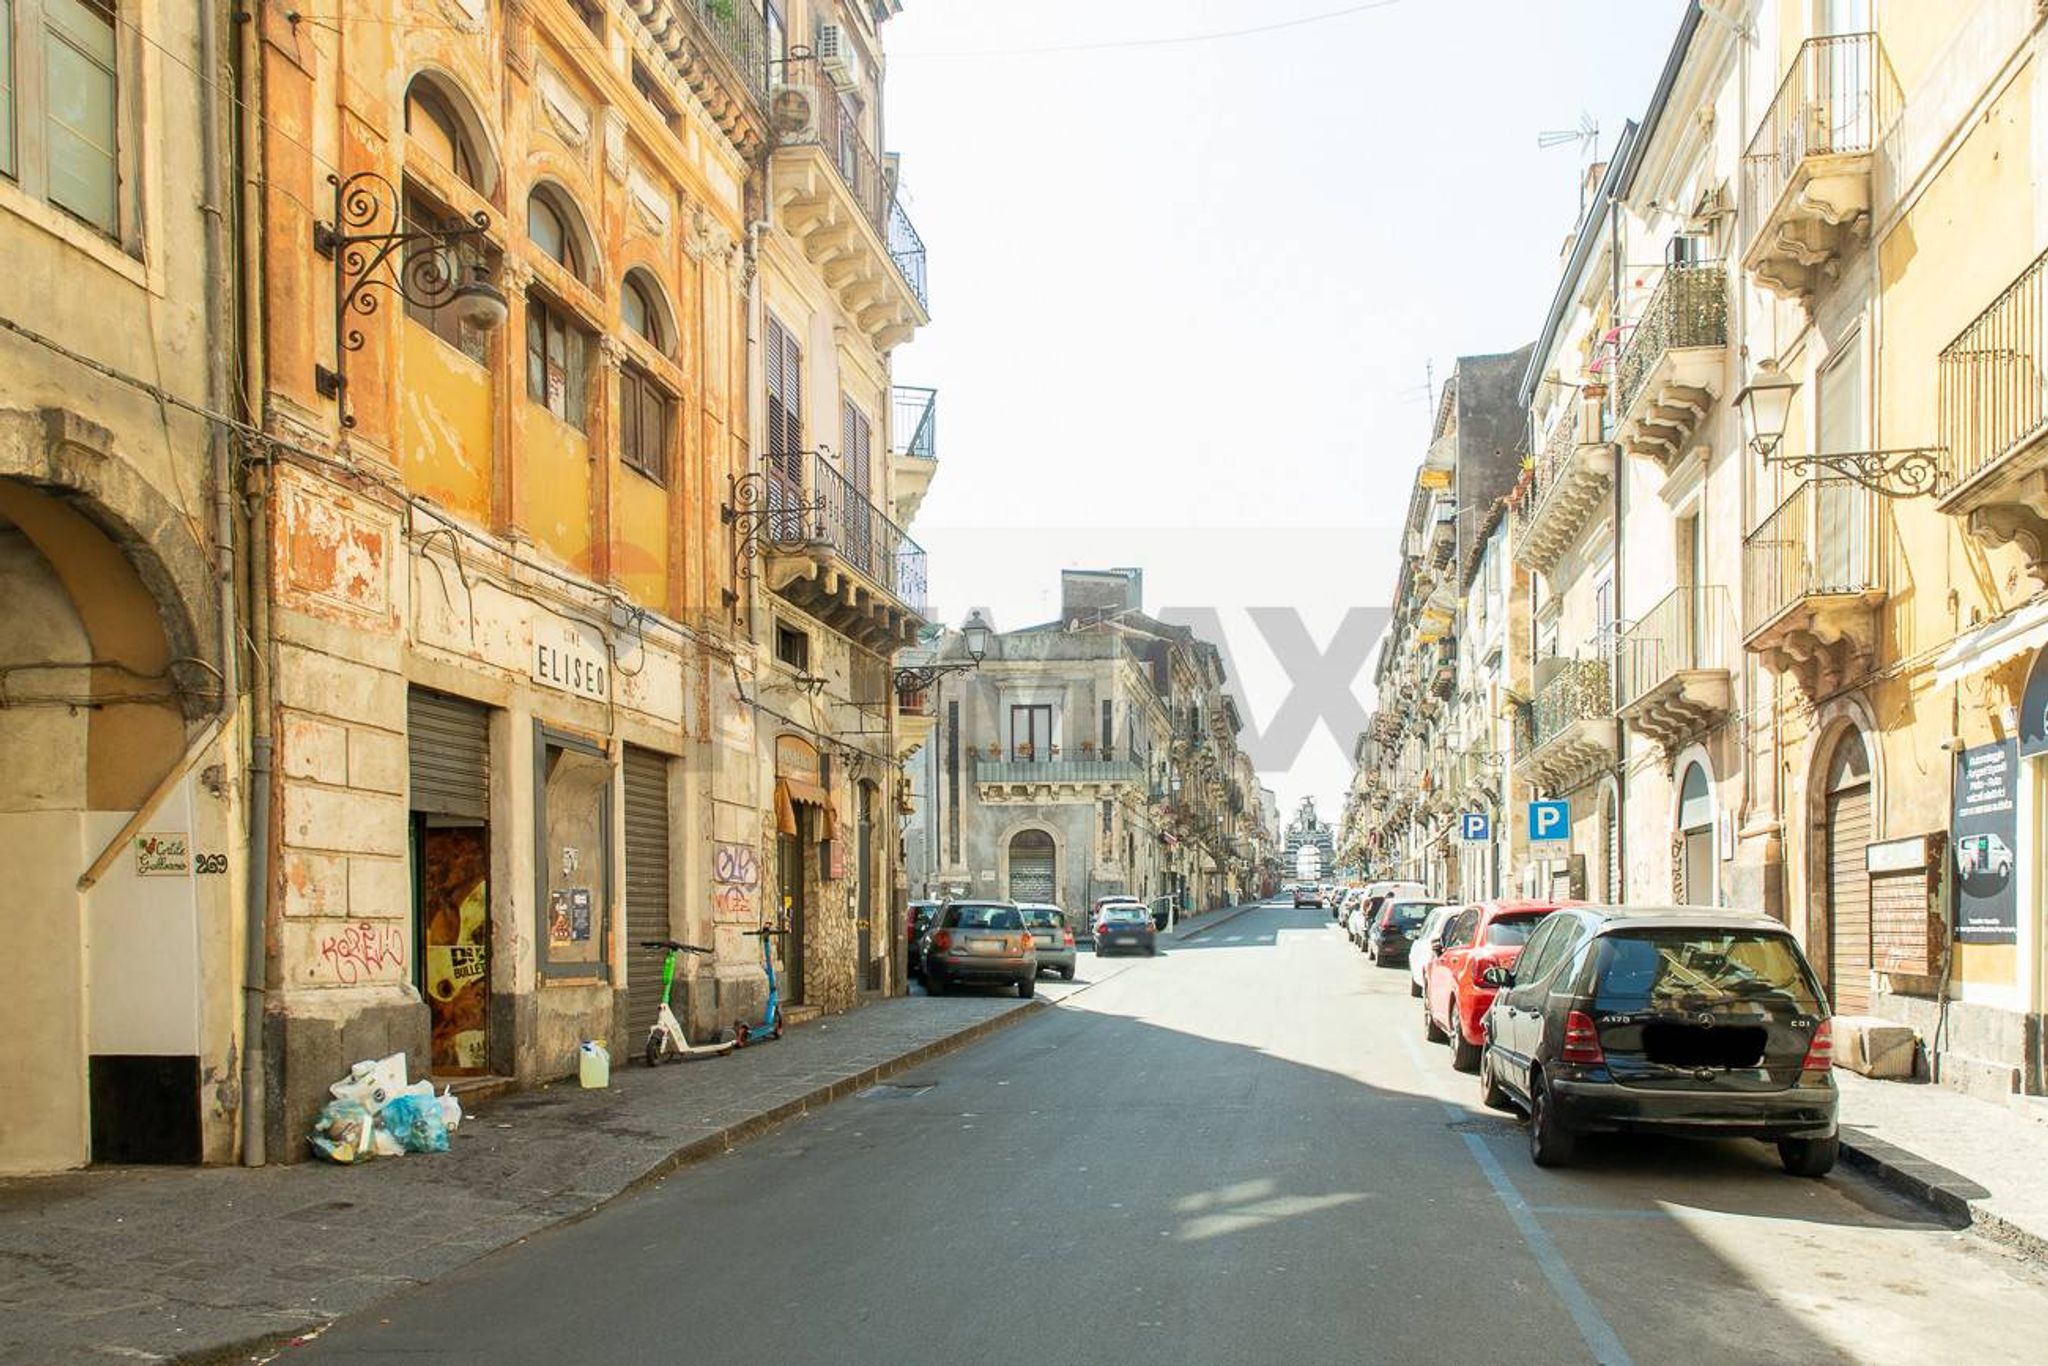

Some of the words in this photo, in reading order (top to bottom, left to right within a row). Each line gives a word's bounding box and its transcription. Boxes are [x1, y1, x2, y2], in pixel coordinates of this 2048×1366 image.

[538, 644, 605, 696] ELISEO
[1468, 816, 1484, 838] P
[1537, 806, 1560, 836] P
[195, 853, 228, 875] 269
